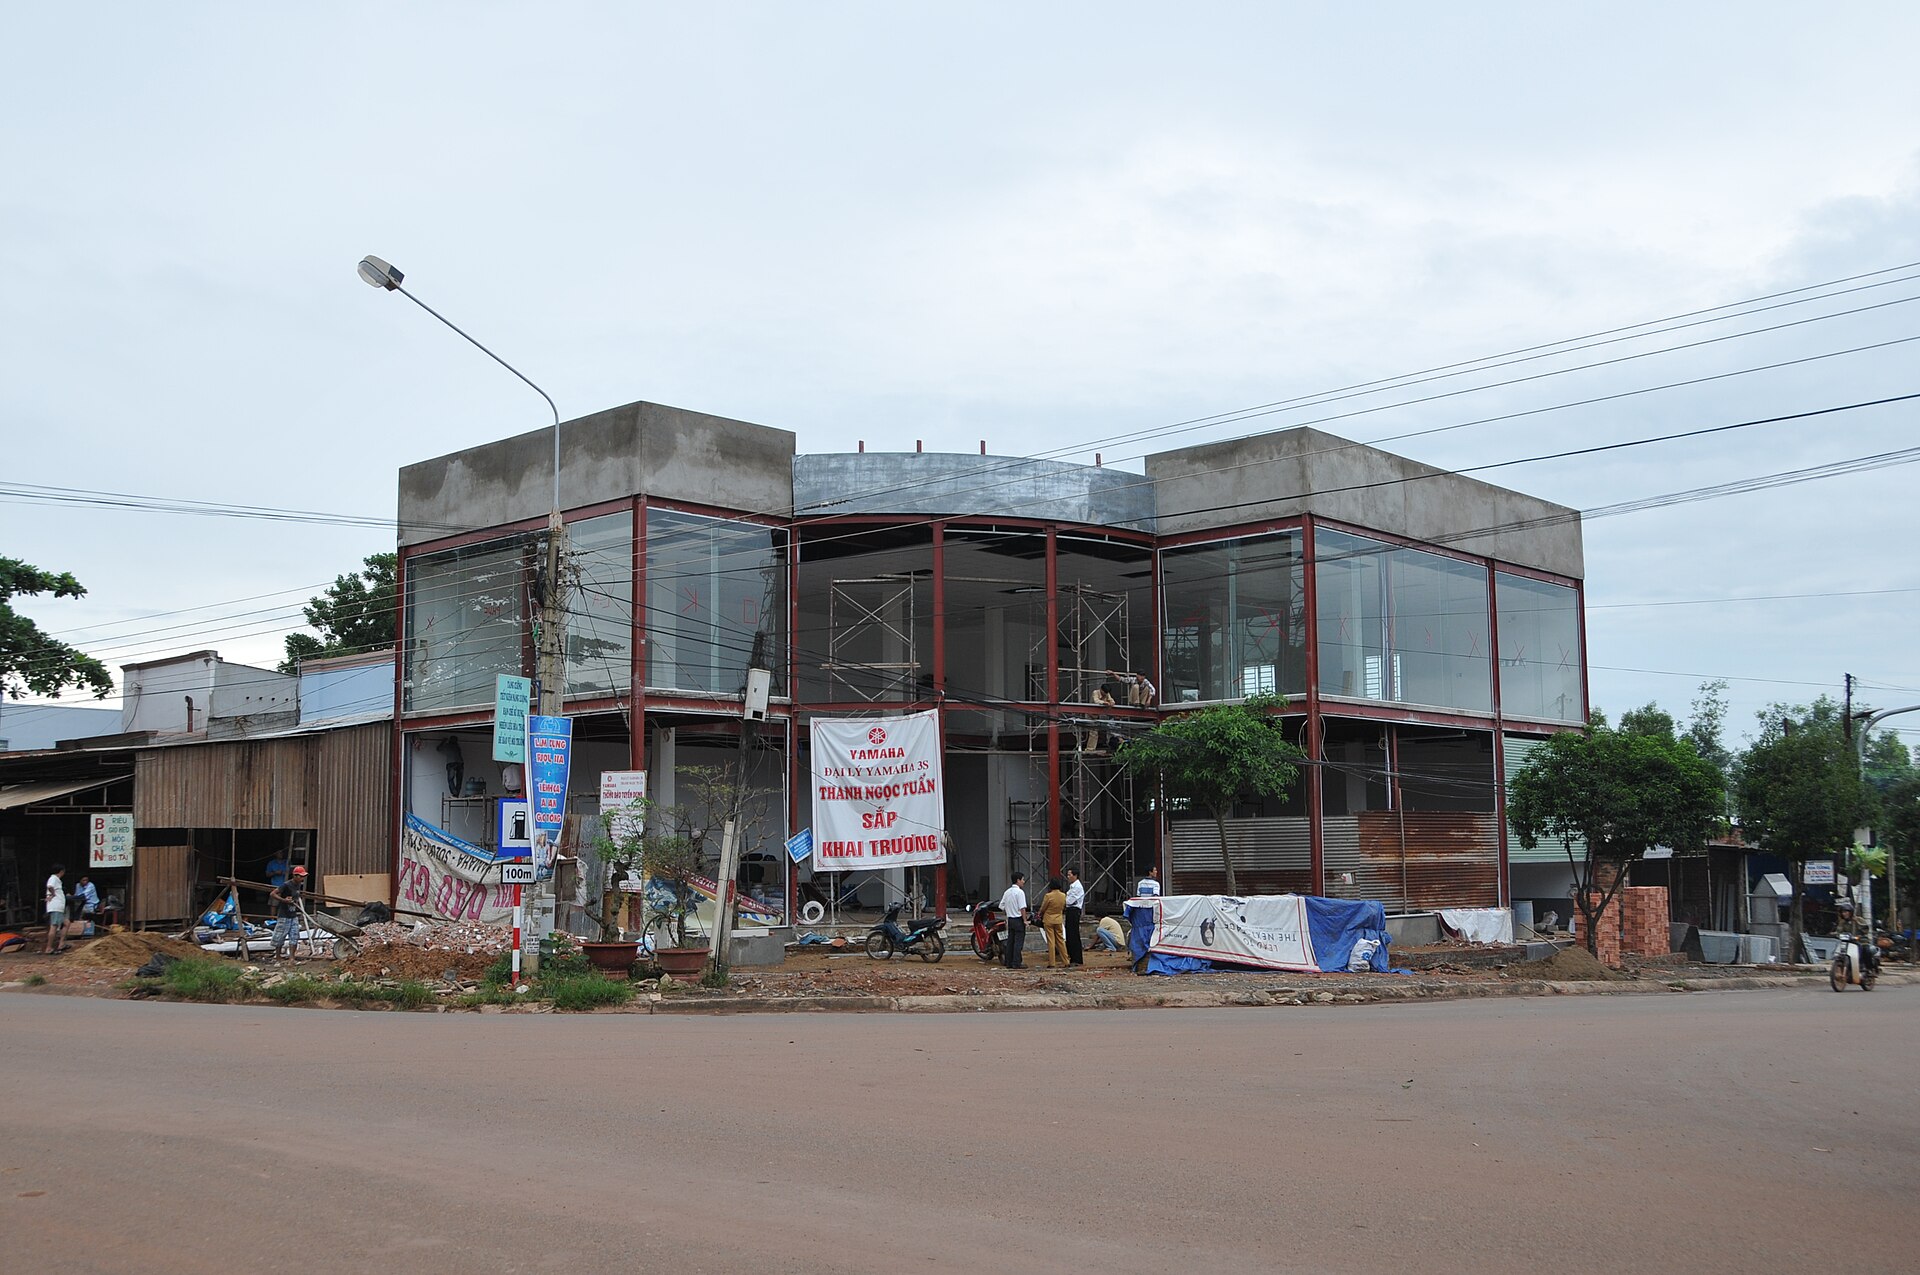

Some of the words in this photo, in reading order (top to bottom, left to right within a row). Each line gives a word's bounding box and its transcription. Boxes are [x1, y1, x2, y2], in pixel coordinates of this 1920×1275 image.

[850, 747, 905, 760] YAMAHA
[824, 767, 844, 779] ĐẠI
[848, 765, 862, 776] LÝ
[866, 763, 915, 776] YAMAHA
[917, 760, 929, 771] 3S
[819, 786, 863, 801] THANH
[865, 784, 900, 802] NGỌC
[902, 773, 936, 796] TUẤN
[862, 806, 897, 829] SẮP
[822, 841, 864, 858] KHAI
[869, 834, 937, 857] TRƯƠNG
[505, 868, 532, 879] 100m
[1279, 931, 1297, 942] THE
[1257, 941, 1279, 952] LEAD
